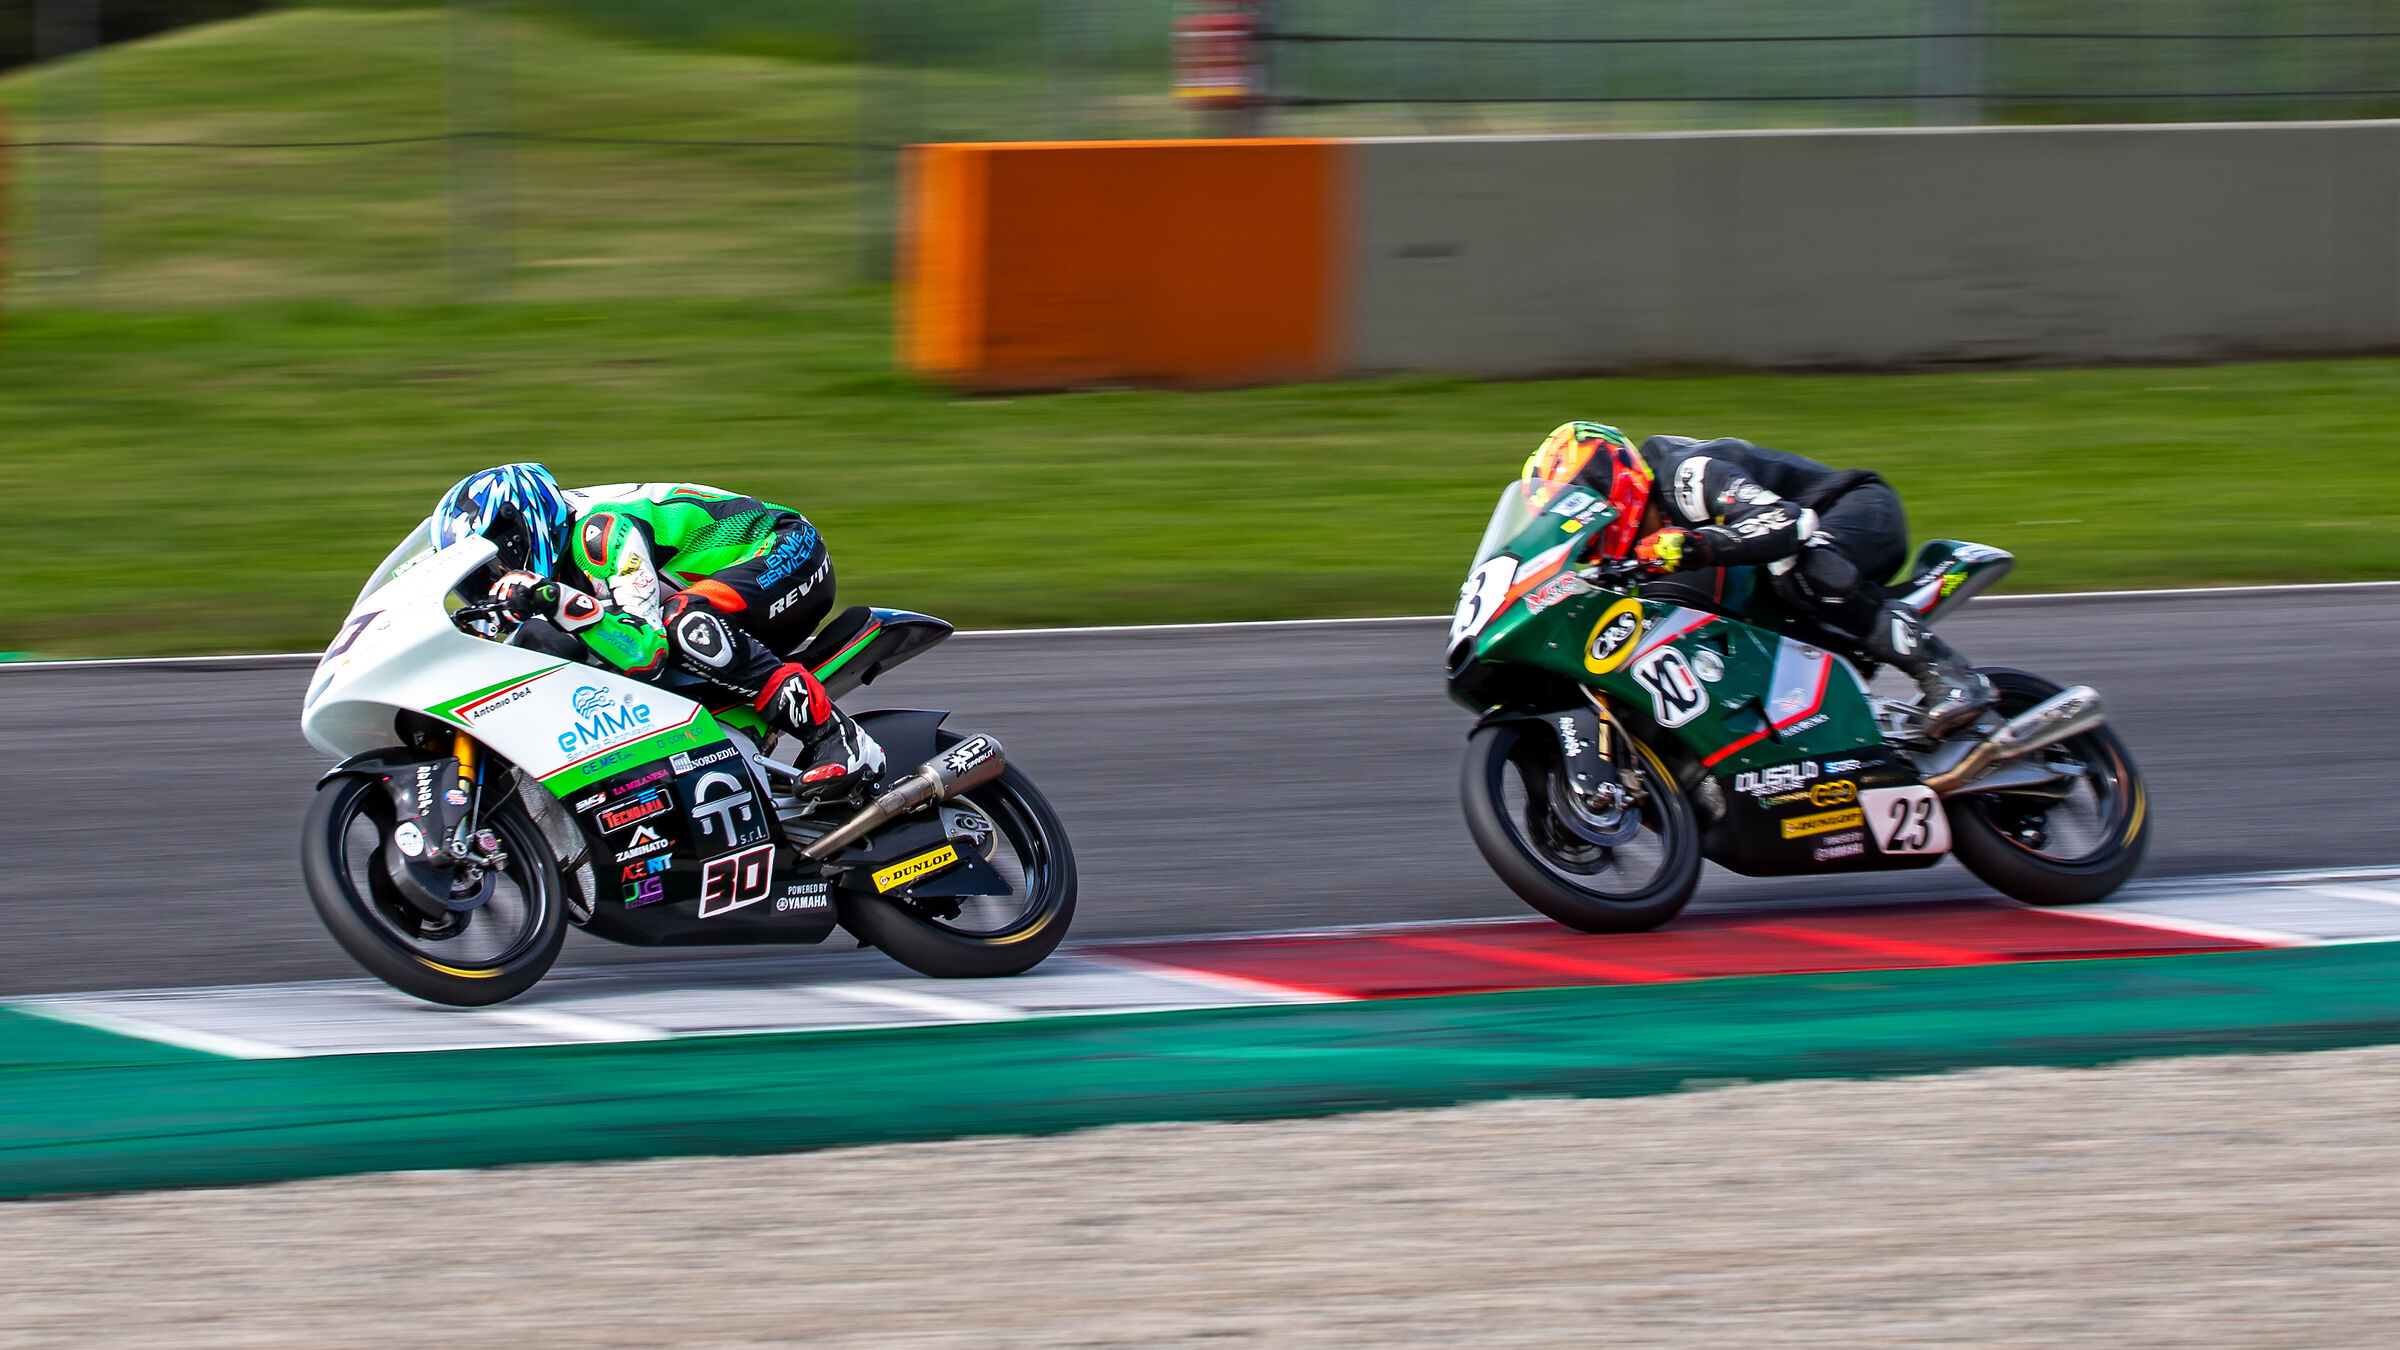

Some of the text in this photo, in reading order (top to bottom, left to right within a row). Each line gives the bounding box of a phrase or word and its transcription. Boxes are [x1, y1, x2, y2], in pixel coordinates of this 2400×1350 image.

[473, 698, 511, 720] Antonio
[691, 746, 739, 769] NORD EDIL
[1886, 797, 1932, 850] 23
[893, 852, 952, 880] DUNLOP
[702, 845, 774, 917] 30
[788, 883, 828, 896] POWERED BY
[788, 894, 828, 910] YAMAHA
